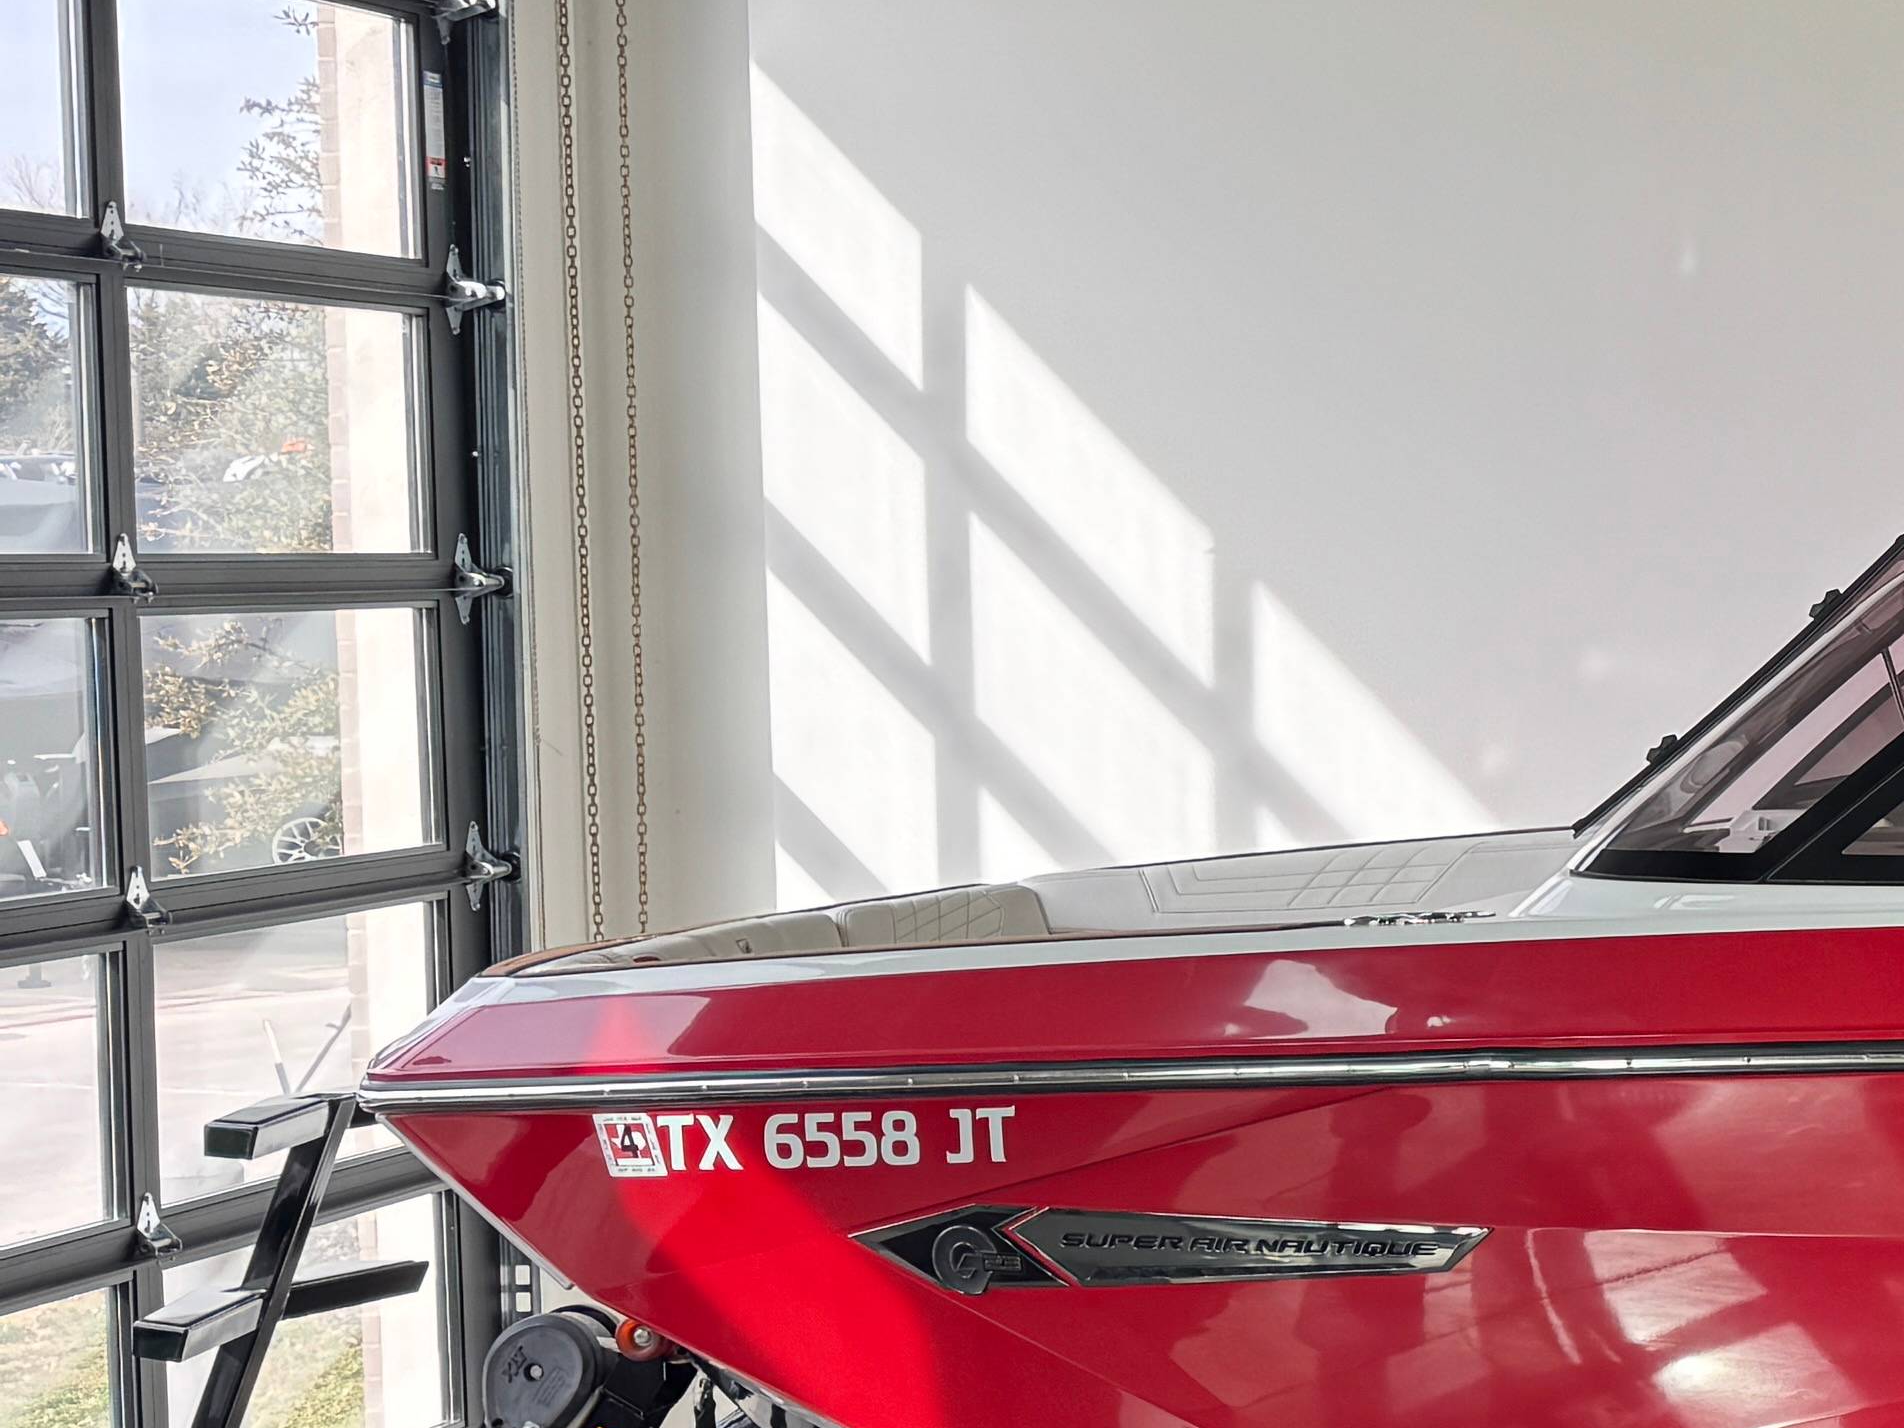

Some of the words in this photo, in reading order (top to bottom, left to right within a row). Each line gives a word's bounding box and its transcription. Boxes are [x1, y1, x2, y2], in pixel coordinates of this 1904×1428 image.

[663, 1110, 743, 1170] TX
[763, 1109, 921, 1169] 6558
[945, 1104, 1016, 1166] JT
[1059, 1232, 1183, 1251] SUPER
[1190, 1234, 1248, 1253] AIR
[1253, 1236, 1440, 1258] NAUTIQUE
